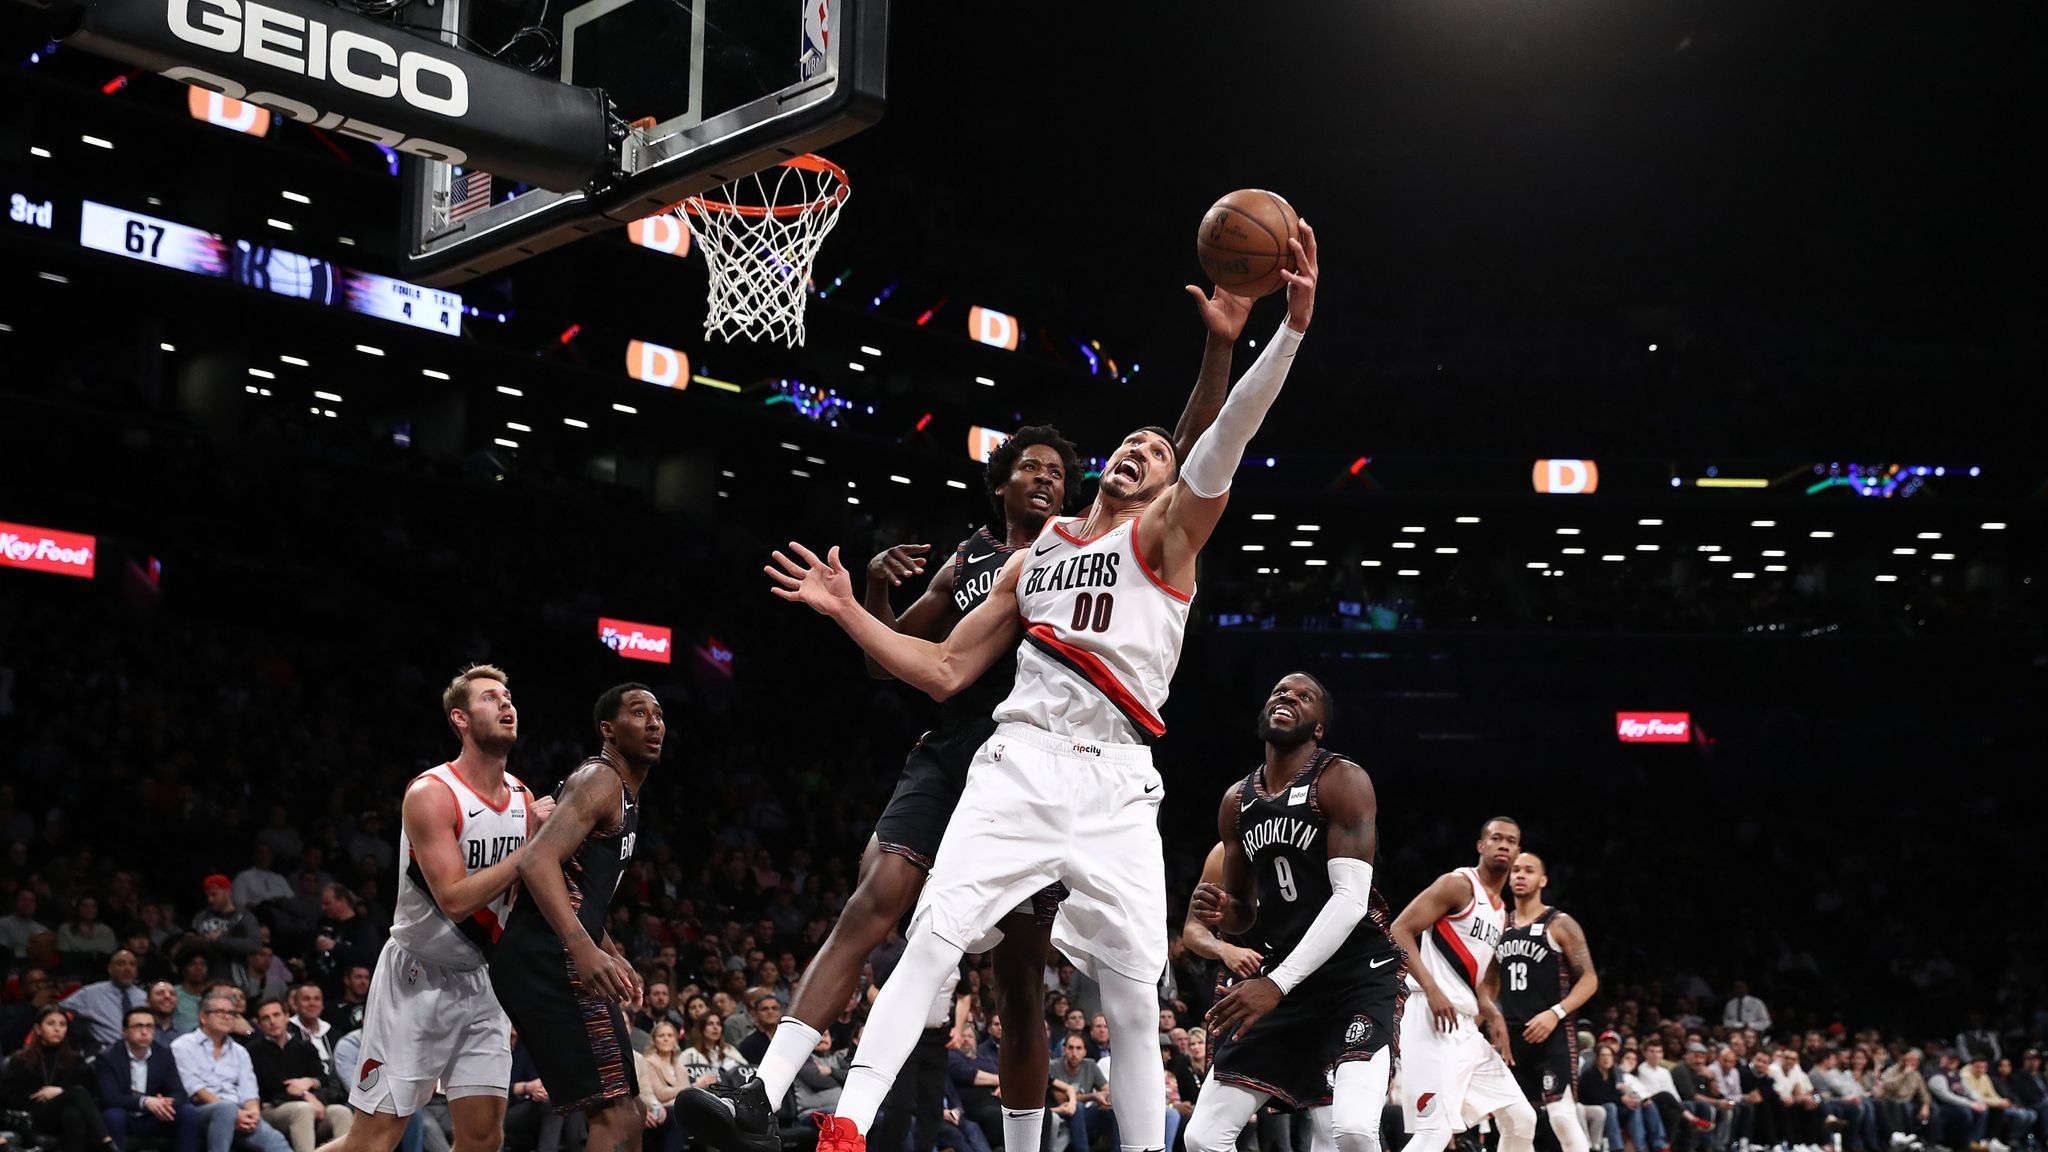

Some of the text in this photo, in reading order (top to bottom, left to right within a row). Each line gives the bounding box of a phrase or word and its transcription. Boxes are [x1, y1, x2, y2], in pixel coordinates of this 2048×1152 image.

[166, 0, 468, 117] GEICO
[10, 193, 53, 229] 3rd
[125, 219, 165, 258] 67
[642, 214, 680, 254] D
[403, 302, 449, 328] 4 4
[980, 308, 1010, 348] D
[641, 342, 679, 387] D
[1548, 459, 1587, 493] D
[1025, 552, 1121, 596] BLAZERS
[1070, 592, 1114, 633] 00
[1291, 790, 1307, 799] infor
[1242, 817, 1318, 862] BROOKLYN
[1274, 856, 1298, 902] 9
[1507, 962, 1528, 991] 13
